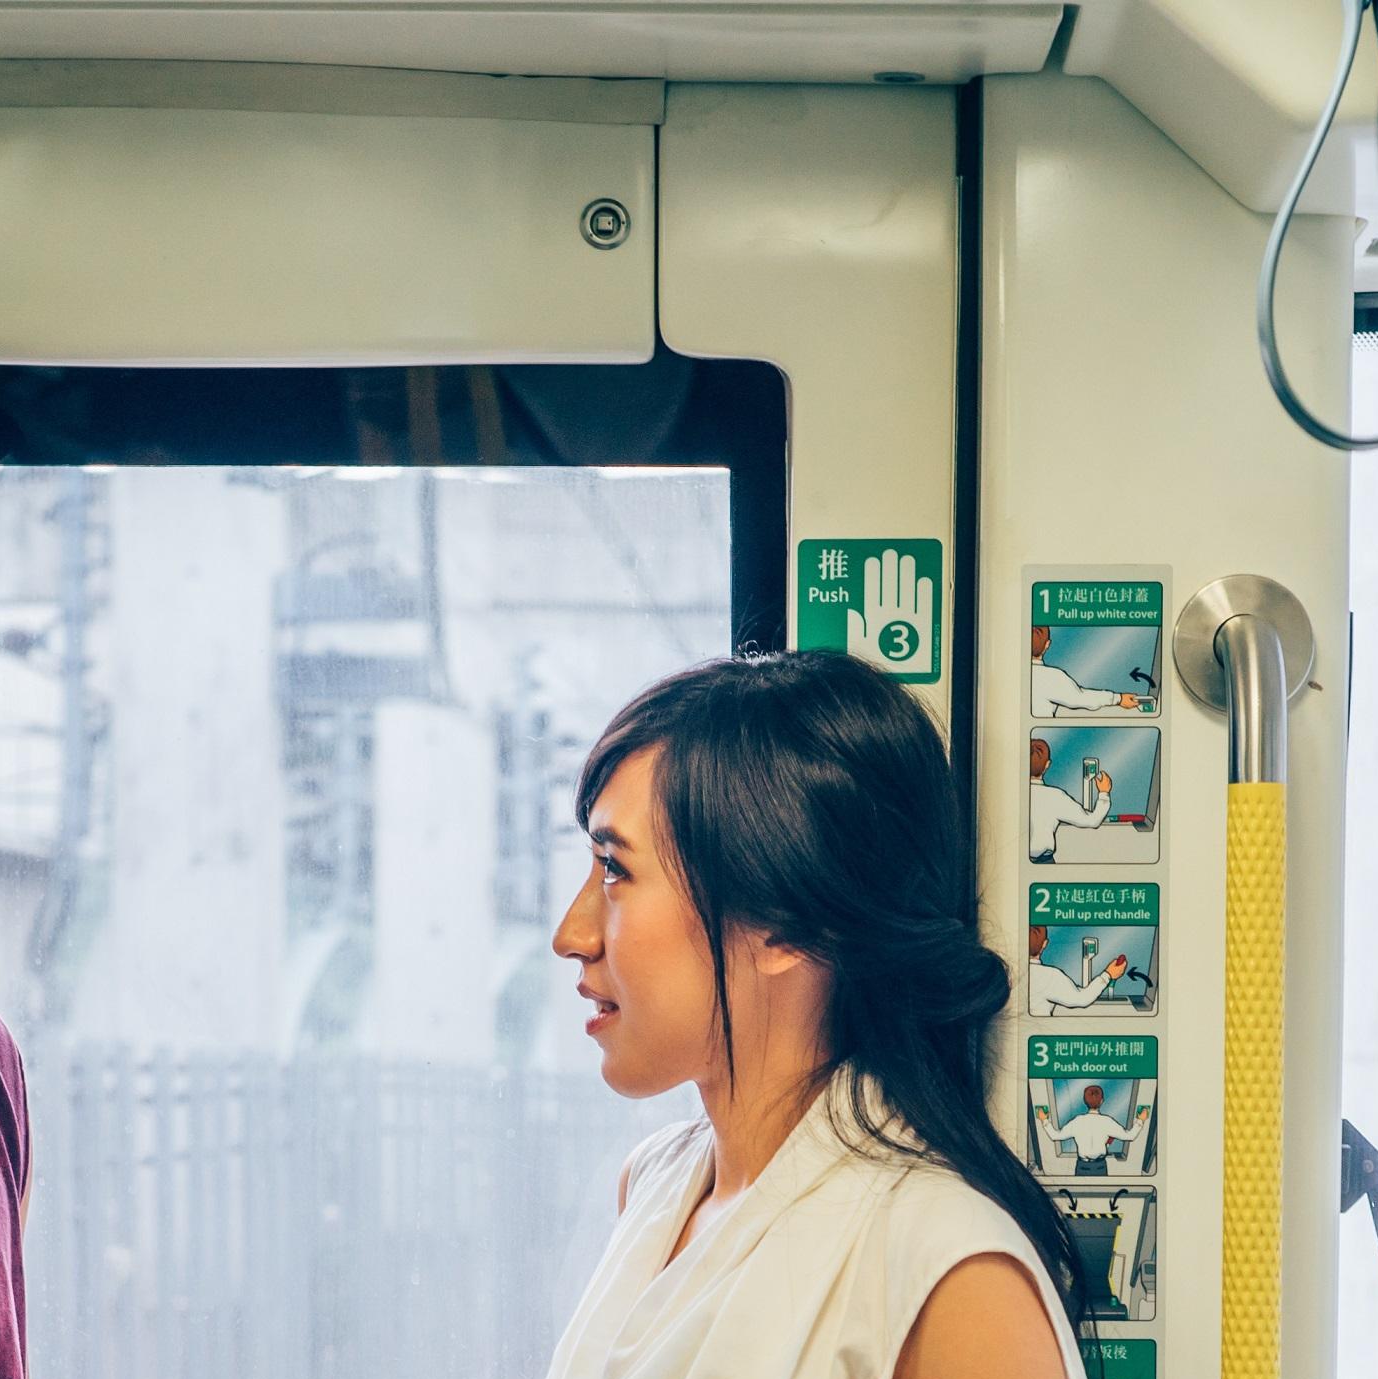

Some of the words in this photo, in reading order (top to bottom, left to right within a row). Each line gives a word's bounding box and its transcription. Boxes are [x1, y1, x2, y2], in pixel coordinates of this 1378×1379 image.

[817, 548, 849, 581] 推
[808, 586, 850, 603] Push
[1039, 589, 1050, 614] 1
[1058, 587, 1149, 603] 拉起白色封蓋
[1057, 608, 1078, 619] Pull
[1080, 609, 1094, 621] up
[1097, 608, 1126, 619] white
[1129, 610, 1158, 619] cover
[888, 624, 911, 659] 3
[1034, 888, 1050, 913] 2
[1055, 888, 1146, 904] 拉起紅色手柄
[1055, 909, 1075, 920] Pull
[1077, 911, 1092, 921] up
[1094, 909, 1112, 920] red
[1114, 909, 1151, 920] handle
[1033, 1042, 1050, 1067] 3
[1054, 1041, 1144, 1057] 把門向外推開
[1053, 1061, 1080, 1072] Push
[1081, 1061, 1106, 1073] door
[1109, 1062, 1128, 1073] out
